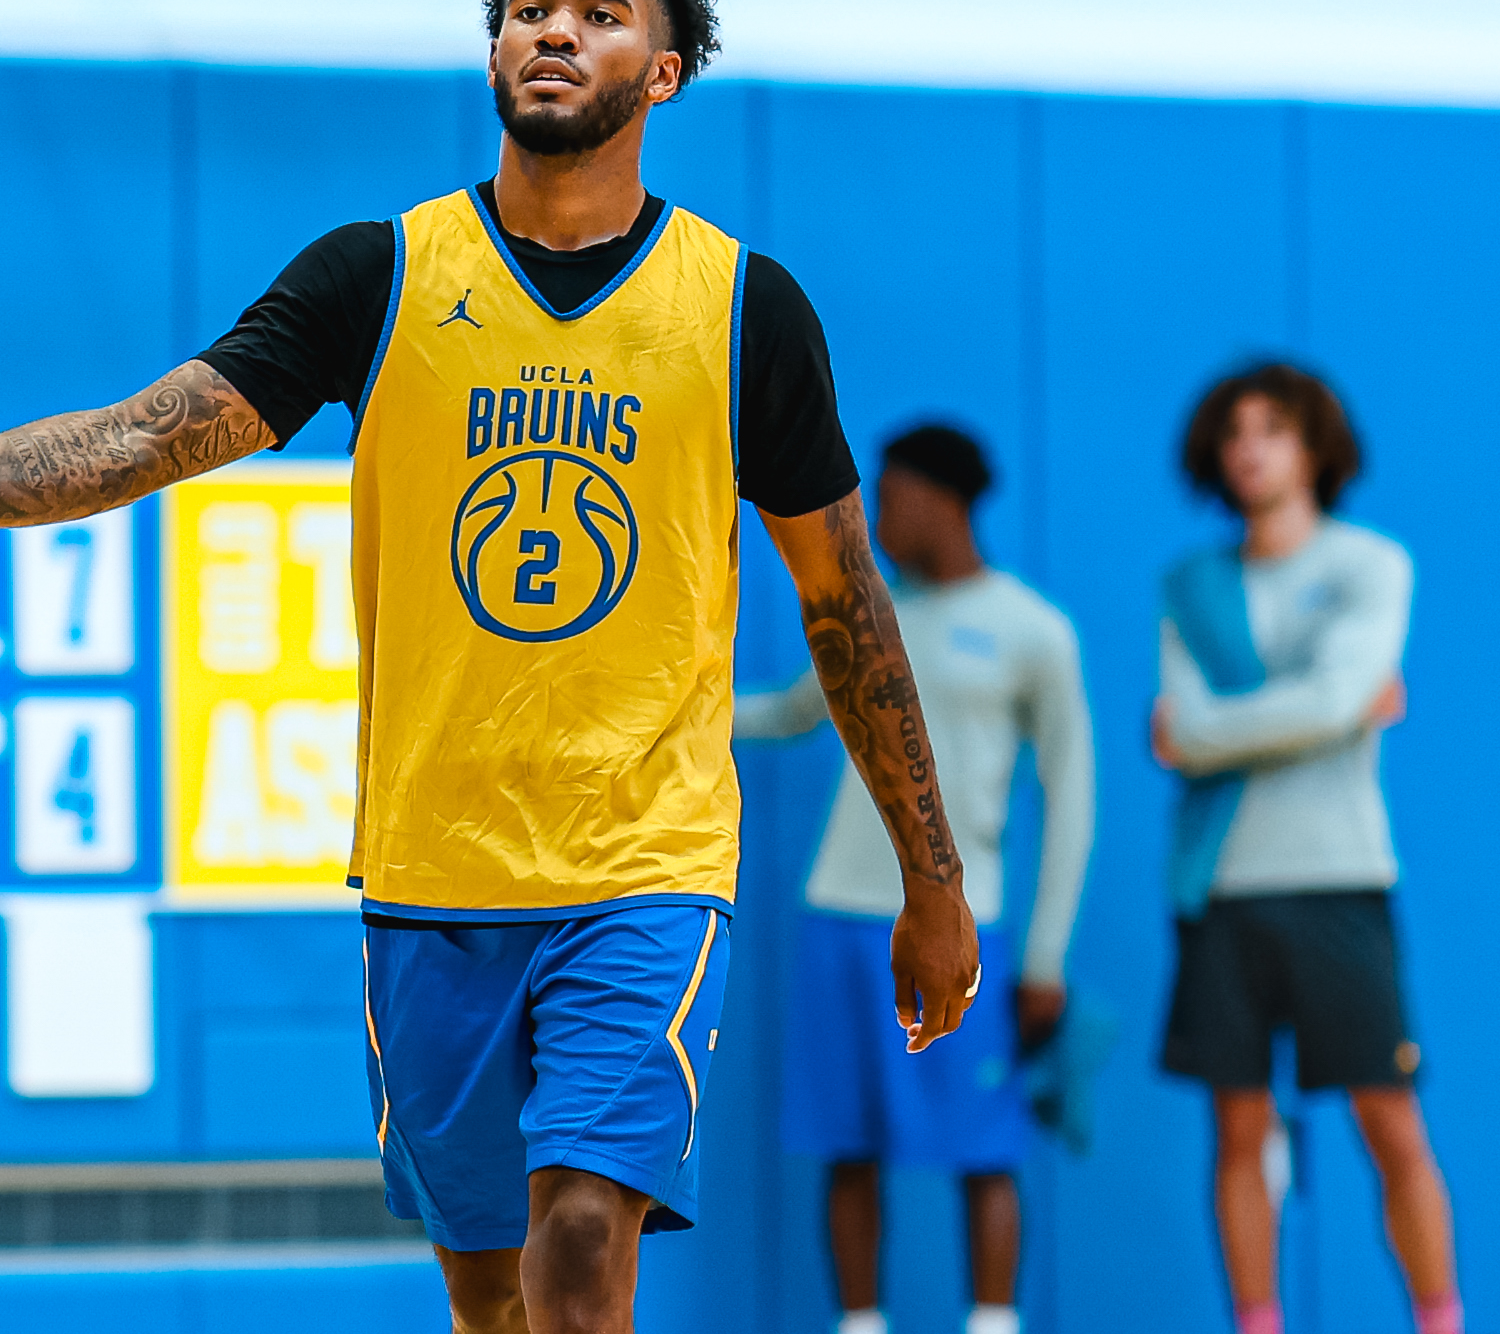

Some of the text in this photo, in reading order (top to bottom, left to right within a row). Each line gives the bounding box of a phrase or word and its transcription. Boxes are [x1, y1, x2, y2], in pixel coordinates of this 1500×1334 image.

[520, 365, 595, 385] UCLA
[466, 387, 642, 465] BRUINS
[52, 528, 94, 647] 7
[513, 529, 561, 605] 2
[55, 727, 97, 847] 4
[899, 714, 952, 868] FEAR GOD
